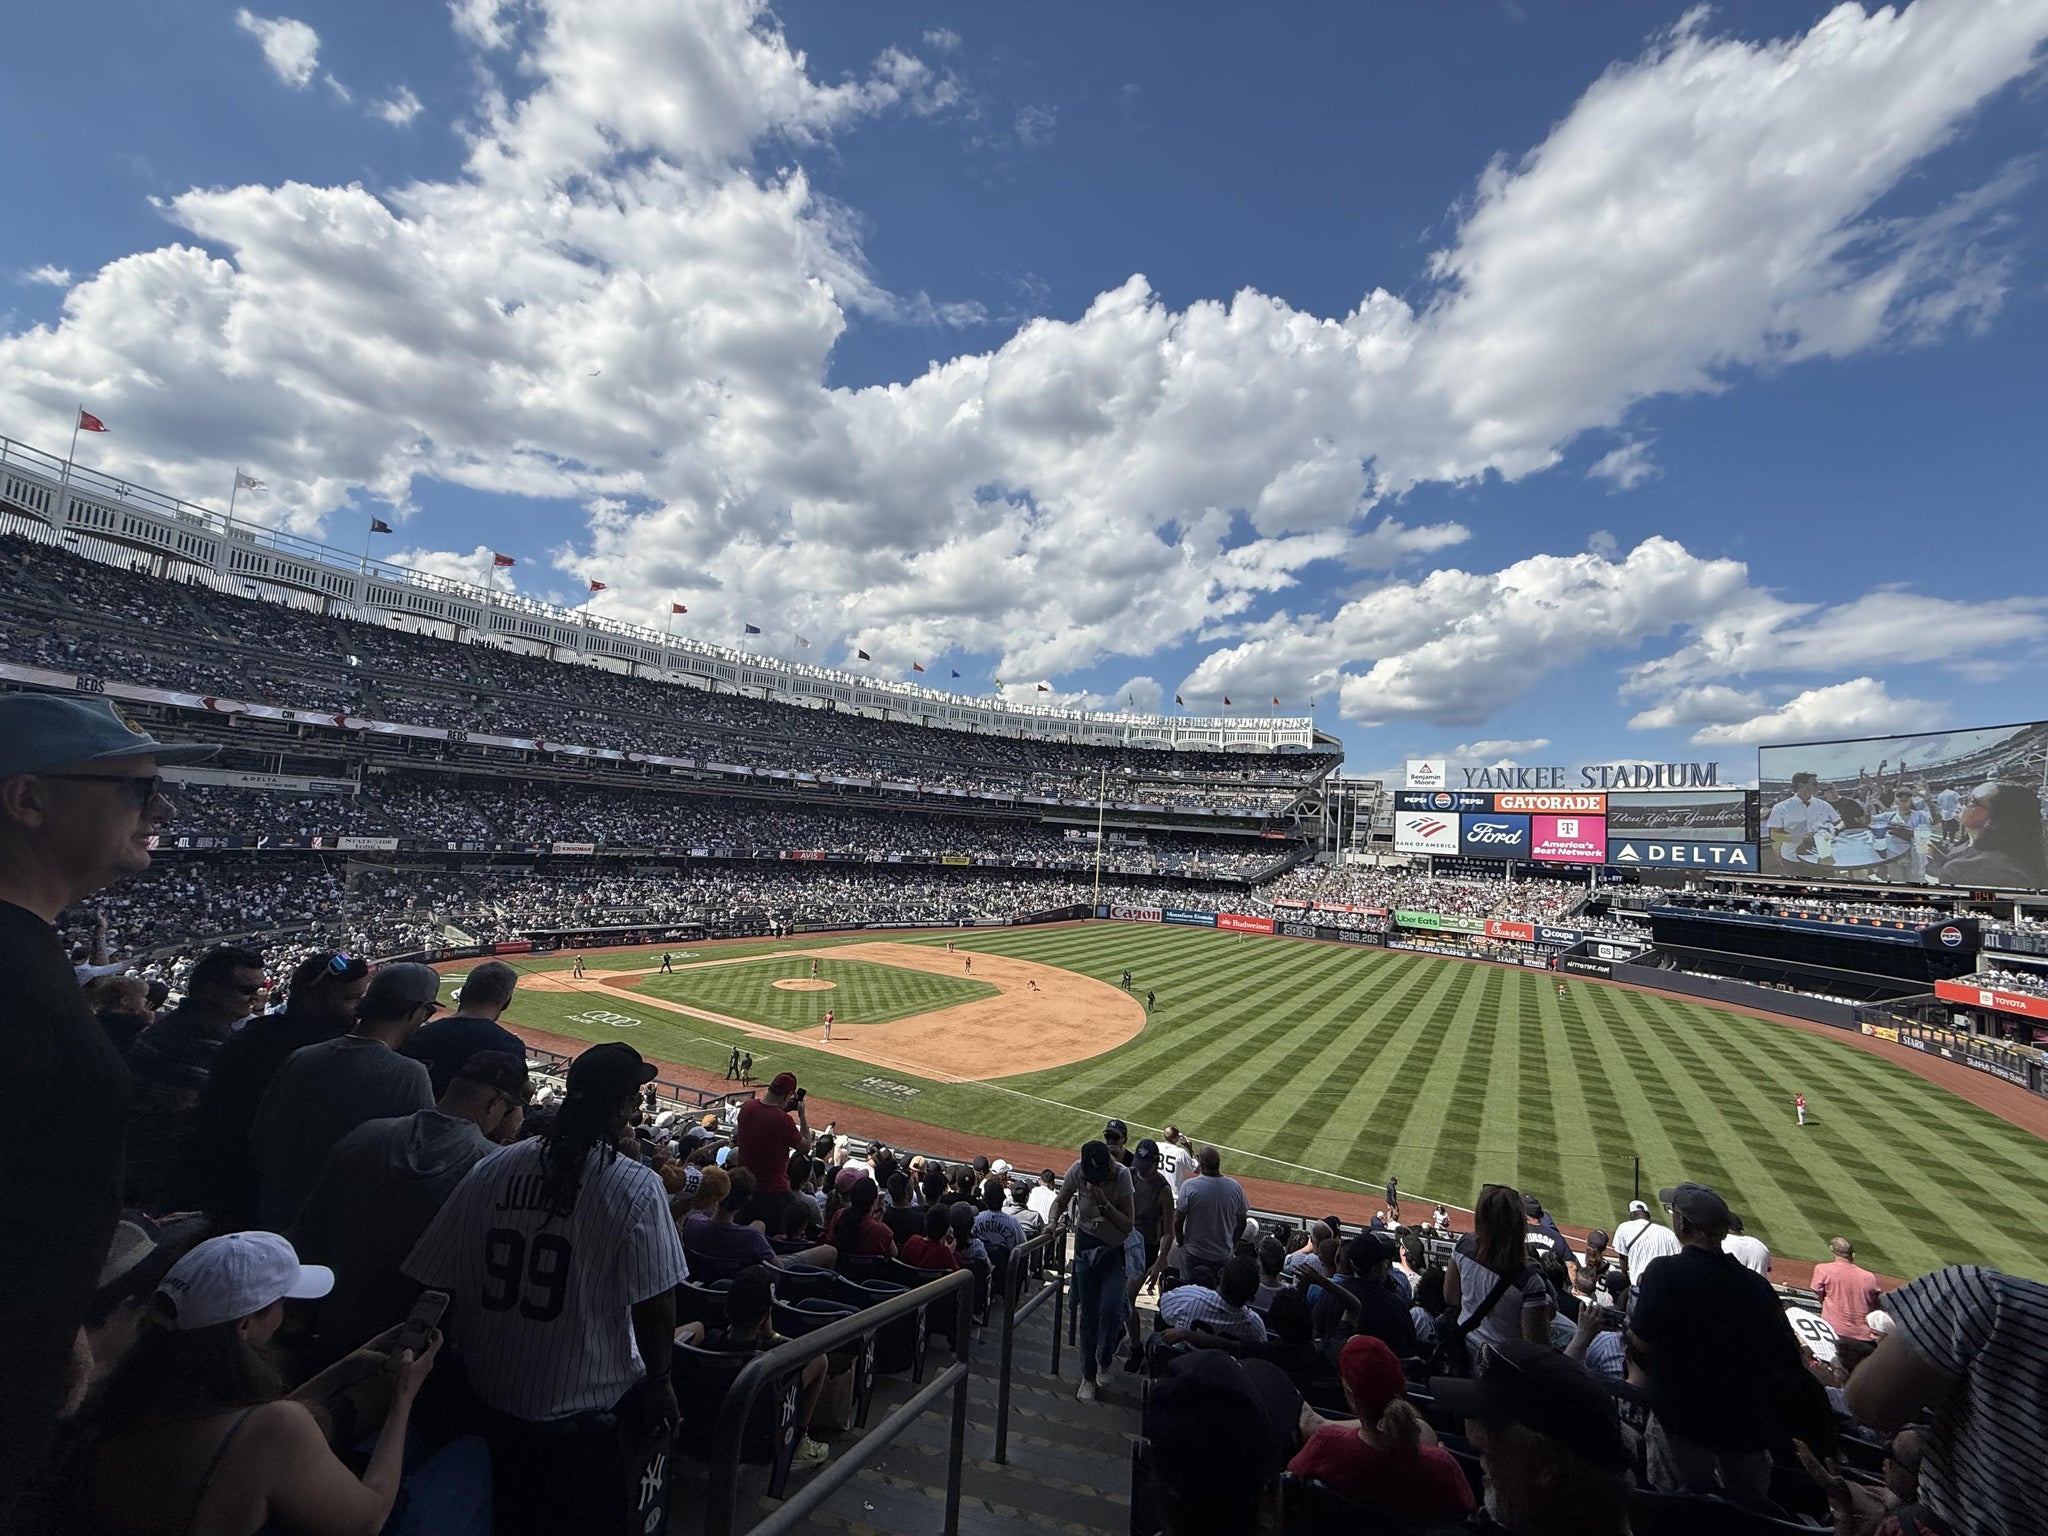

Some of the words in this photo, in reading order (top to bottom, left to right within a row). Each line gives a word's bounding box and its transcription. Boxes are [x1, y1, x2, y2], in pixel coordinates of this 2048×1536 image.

[76, 677, 105, 693] REDS
[282, 710, 295, 719] CIN
[447, 730, 468, 741] REDS
[1461, 767, 1566, 789] YANKEE
[1580, 762, 1719, 789] STADIUM
[1501, 796, 1600, 810] GATORADE
[1644, 811, 1680, 827] York
[1684, 809, 1746, 826] Yankees
[1467, 822, 1523, 845] Ford
[178, 837, 190, 848] ATL
[1541, 840, 1594, 849] America's
[800, 852, 818, 860] AVIS
[1533, 847, 1557, 855] Best
[1557, 848, 1603, 857] Network
[1649, 845, 1748, 865] DELTA
[1111, 906, 1161, 921] Canon
[1397, 914, 1416, 924] Uber
[1417, 916, 1438, 926] Eats
[1232, 919, 1271, 930] Budweiser
[1551, 930, 1574, 940] coupa
[1984, 933, 2002, 948] ATL
[1389, 941, 1414, 950] StubHub
[1415, 944, 1440, 953] StubHub
[1440, 948, 1466, 957] StubHub
[1600, 947, 1612, 955] GS
[1496, 956, 1519, 965] STARR
[1994, 997, 2027, 1009] TOYOTA
[1902, 1036, 1925, 1050] STARR
[1966, 1057, 1990, 1071] StubHub
[1990, 1064, 2009, 1079] StubHub
[862, 1076, 921, 1096] HOPE
[973, 1220, 1014, 1242] MARTINEZ
[482, 1228, 571, 1322] 99
[1796, 1318, 1837, 1342] 99
